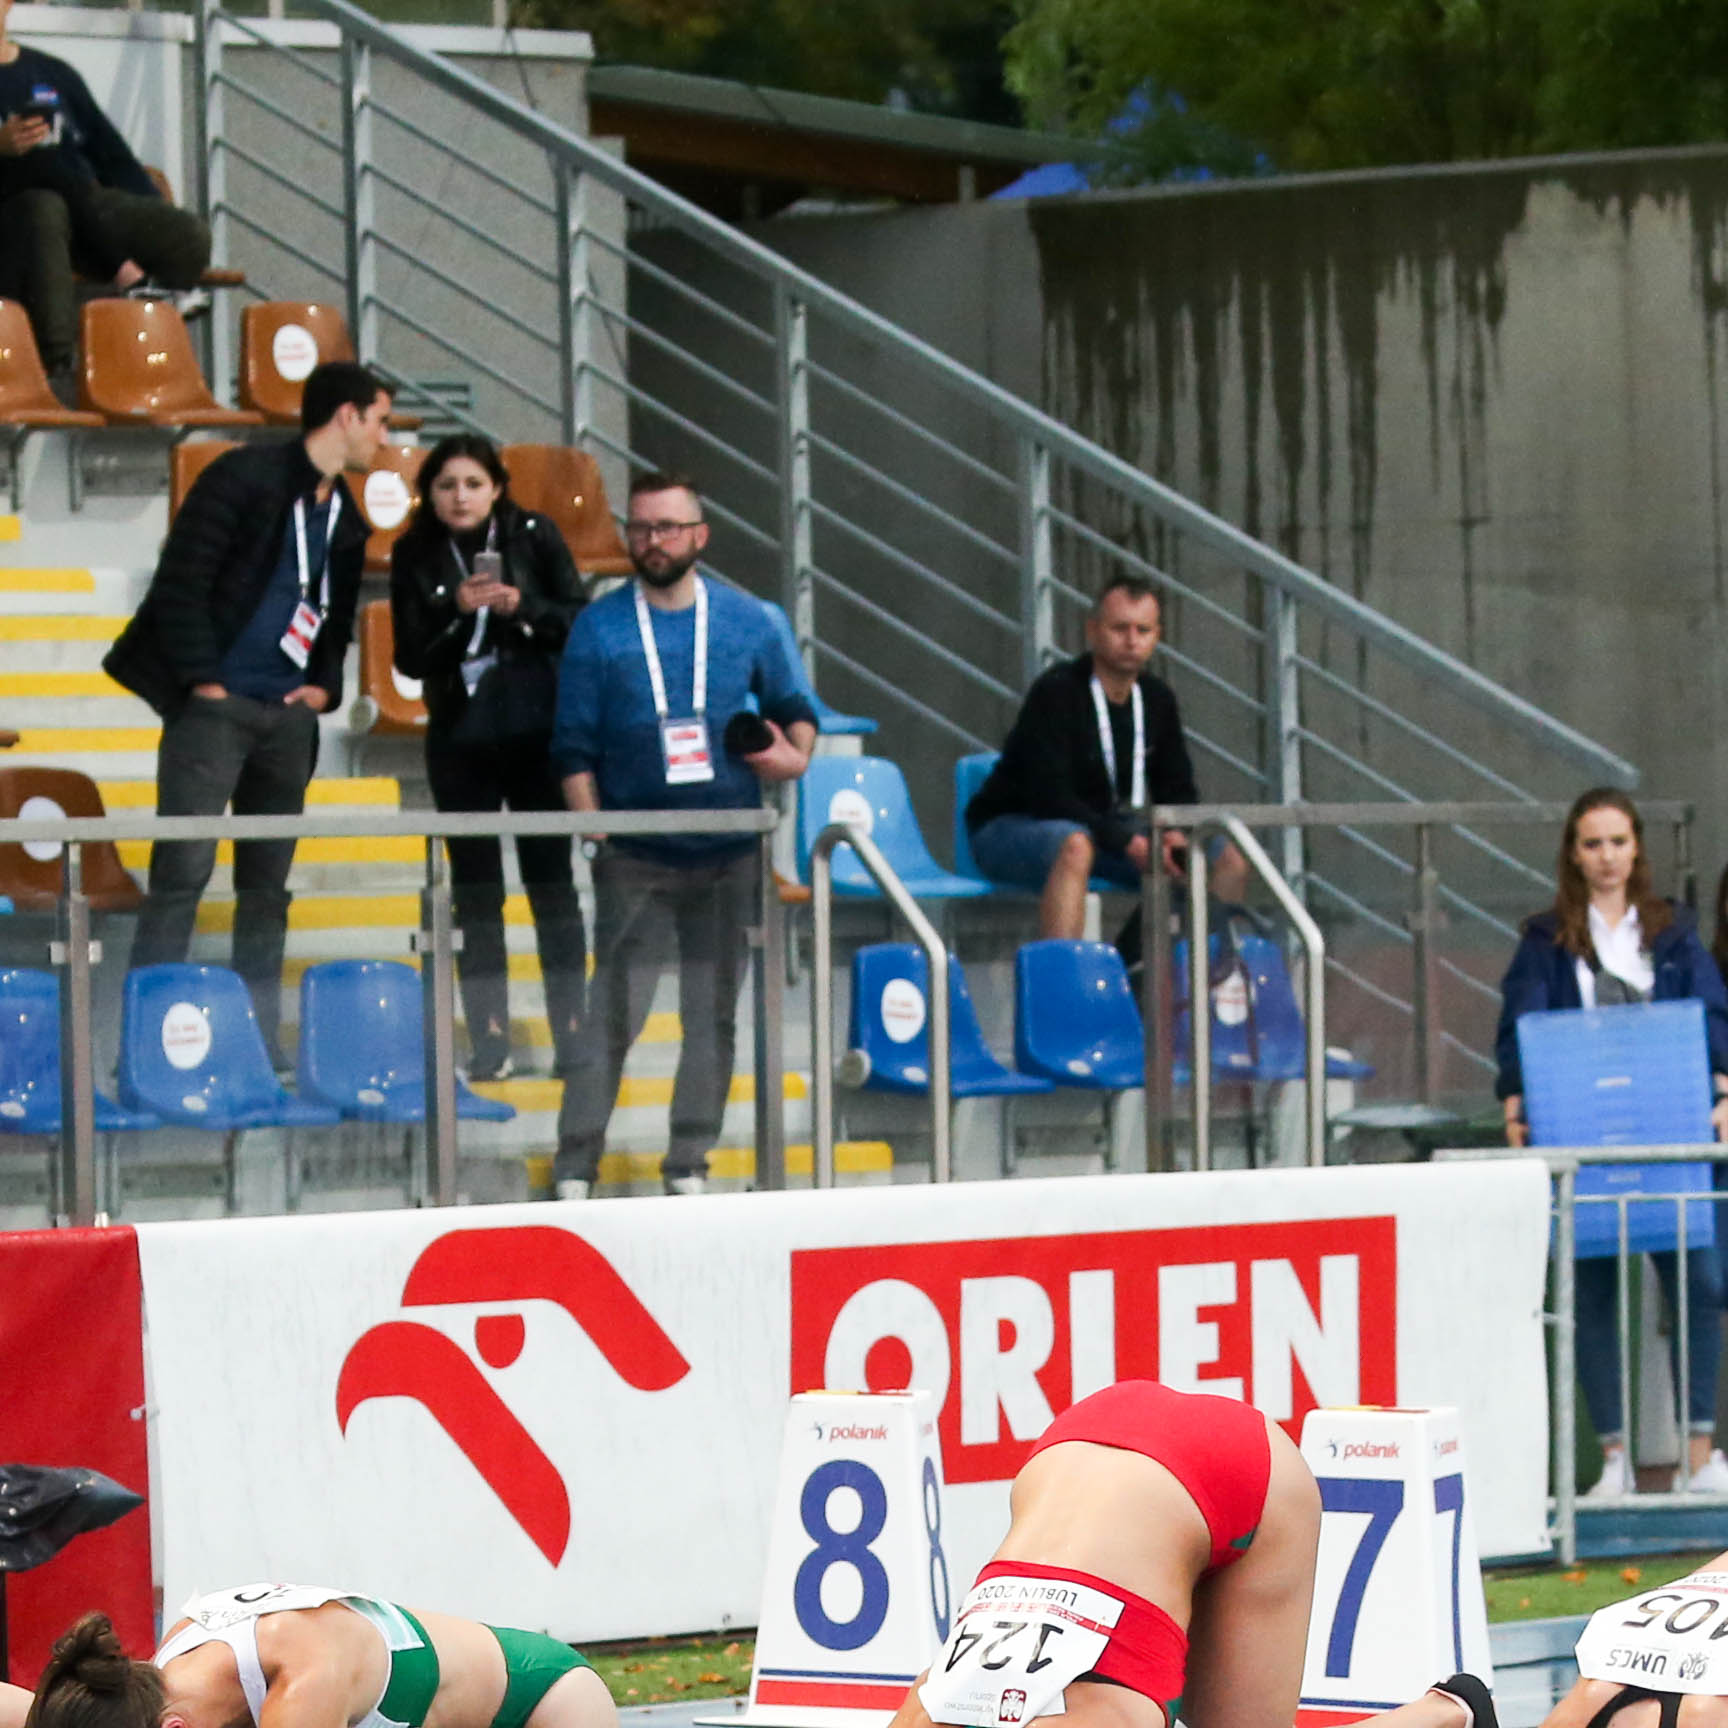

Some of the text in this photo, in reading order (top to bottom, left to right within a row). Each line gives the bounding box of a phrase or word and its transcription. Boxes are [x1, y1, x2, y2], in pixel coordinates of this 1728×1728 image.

[824, 1253, 1361, 1446] ORLEN
[828, 1423, 889, 1443] polanik
[1343, 1441, 1400, 1461] polanik
[794, 1459, 889, 1651] 8
[923, 1456, 951, 1646] 8
[977, 1584, 1078, 1607] LUBLIN 2020
[1315, 1476, 1405, 1679] 7
[1433, 1472, 1464, 1674] 7
[944, 1620, 1064, 1674] 124
[1605, 1648, 1668, 1676] UMCS
